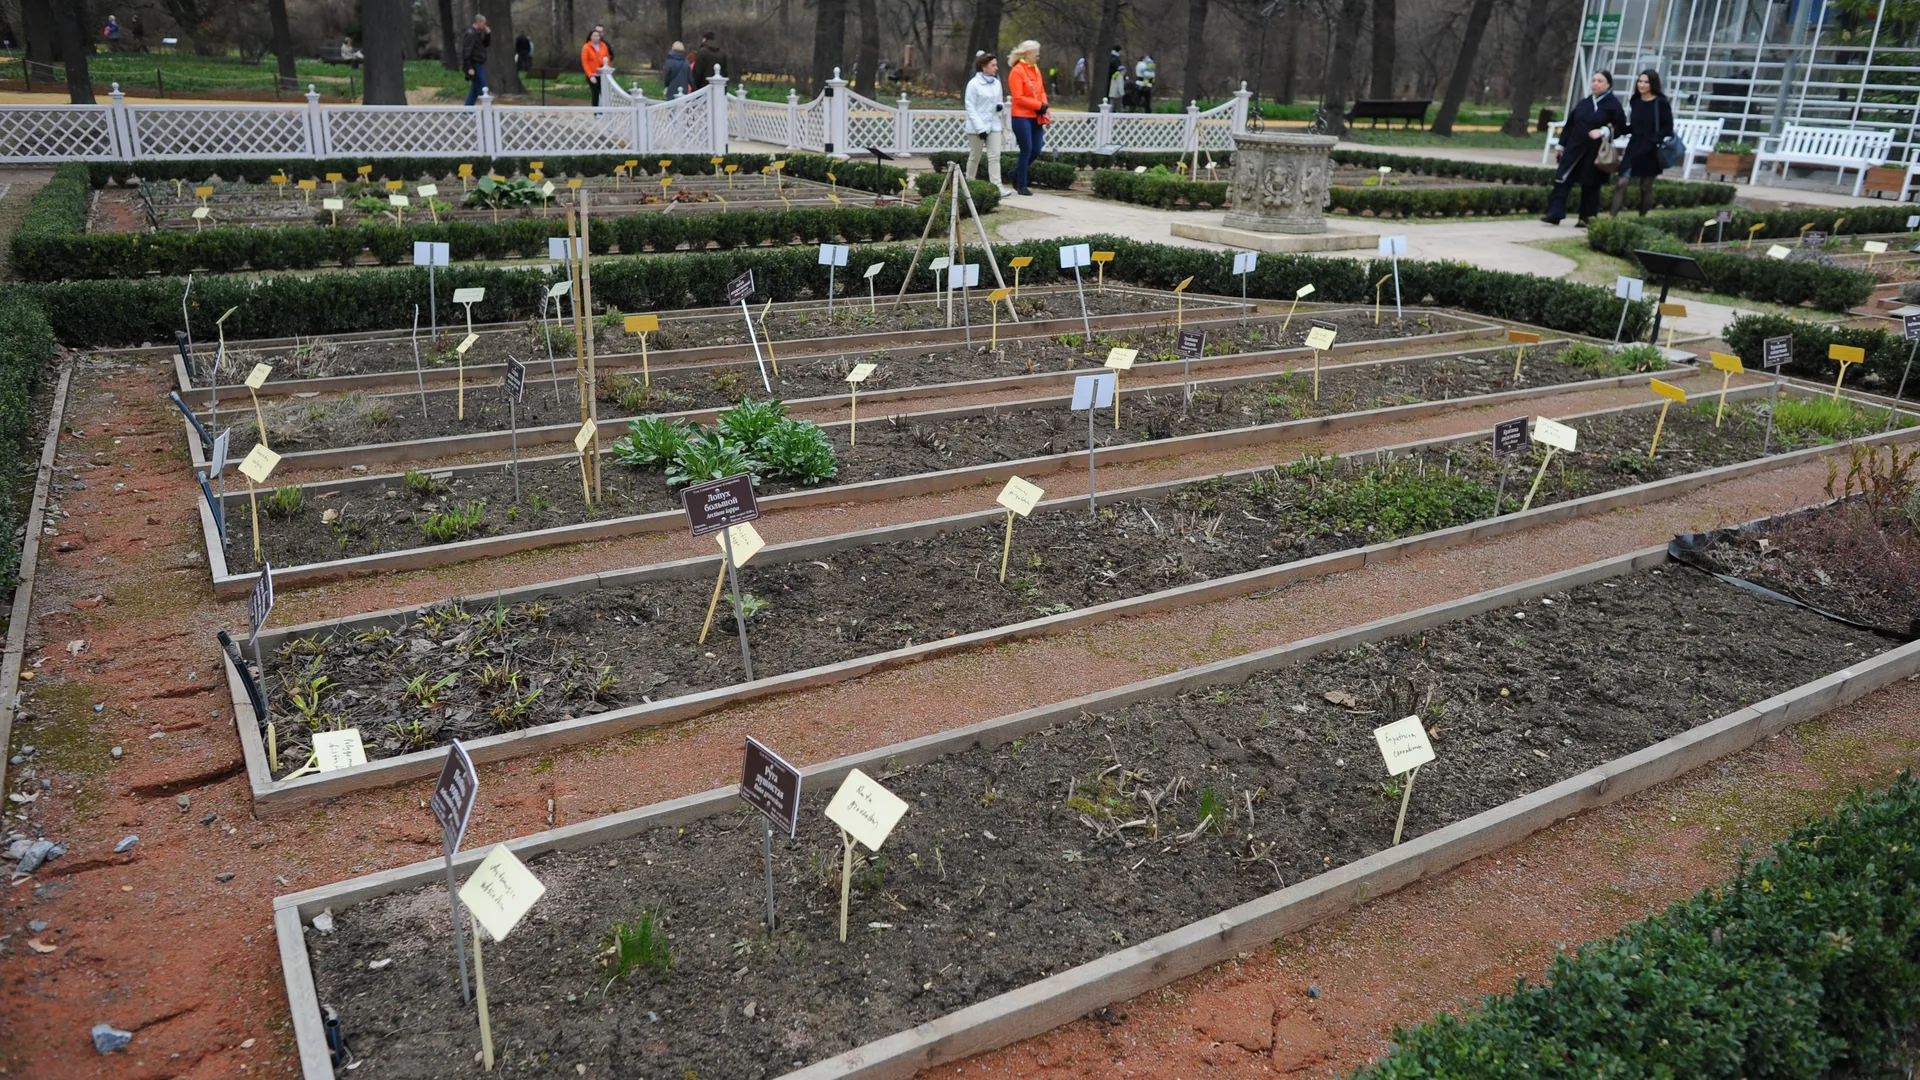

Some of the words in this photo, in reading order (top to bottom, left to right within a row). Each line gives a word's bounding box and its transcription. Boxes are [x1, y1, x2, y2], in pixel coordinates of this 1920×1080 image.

[704, 496, 738, 512] большой
[708, 490, 731, 502] Лопух
[726, 506, 740, 516] lappa
[764, 765, 778, 784] Рута
[755, 774, 784, 800] душистая
